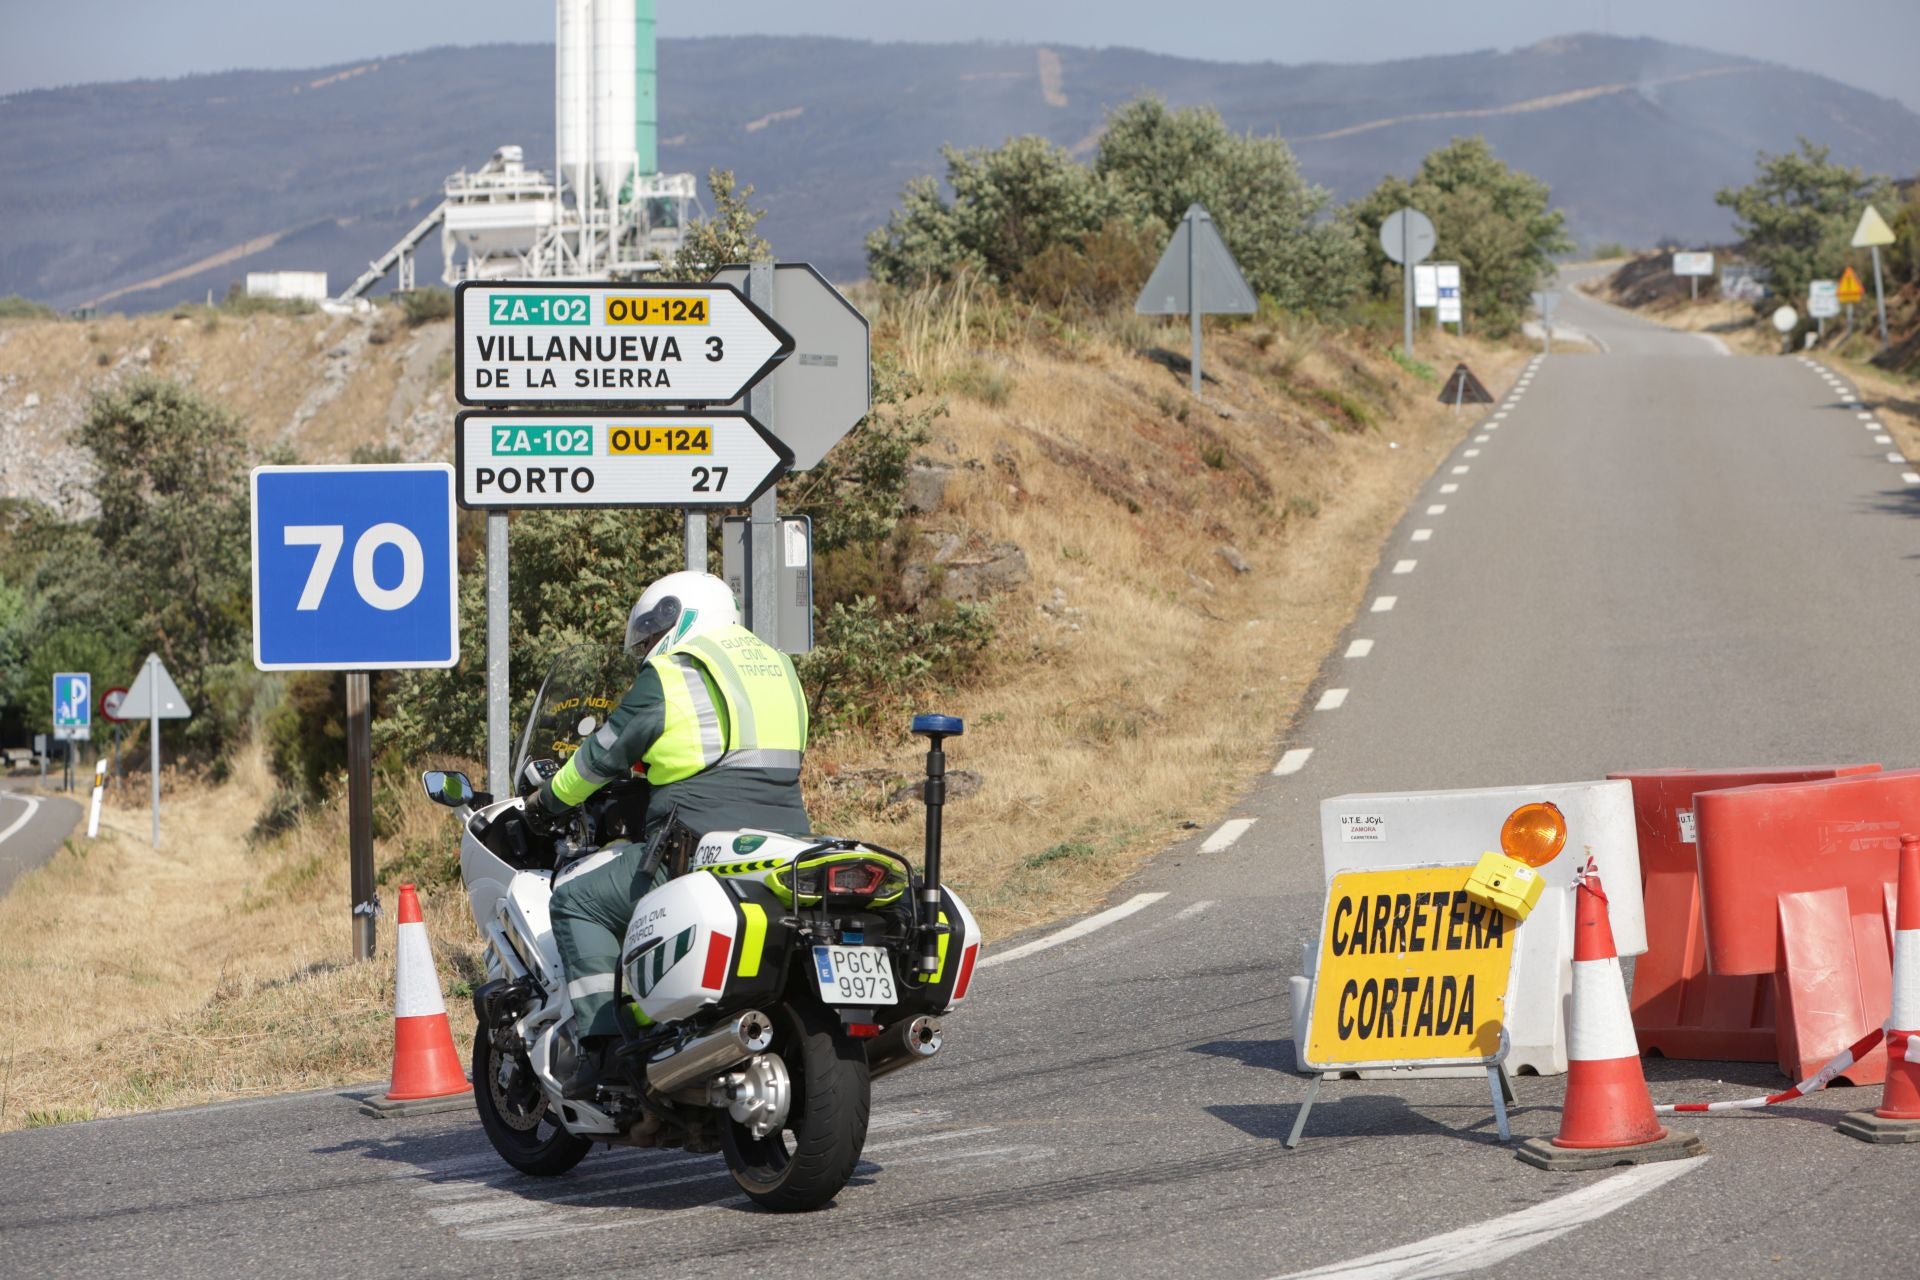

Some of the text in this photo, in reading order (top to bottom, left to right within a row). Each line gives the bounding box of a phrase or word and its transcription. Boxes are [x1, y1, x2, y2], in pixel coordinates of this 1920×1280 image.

[493, 298, 587, 321] ZA-102
[608, 300, 706, 321] OU-124
[476, 335, 724, 362] VILLANUEVA 3
[476, 368, 671, 388] DE LA SIERRA
[496, 429, 589, 452] ZA-102
[611, 430, 709, 451] OU-124
[476, 467, 728, 493] PORTO 27
[284, 522, 424, 611] 70
[1365, 816, 1384, 825] JCyL
[1332, 891, 1504, 957] CARRETERA
[822, 968, 830, 977] E
[834, 951, 887, 975] PGCK
[839, 976, 892, 999] 9973
[1337, 974, 1475, 1041] CORTADA
